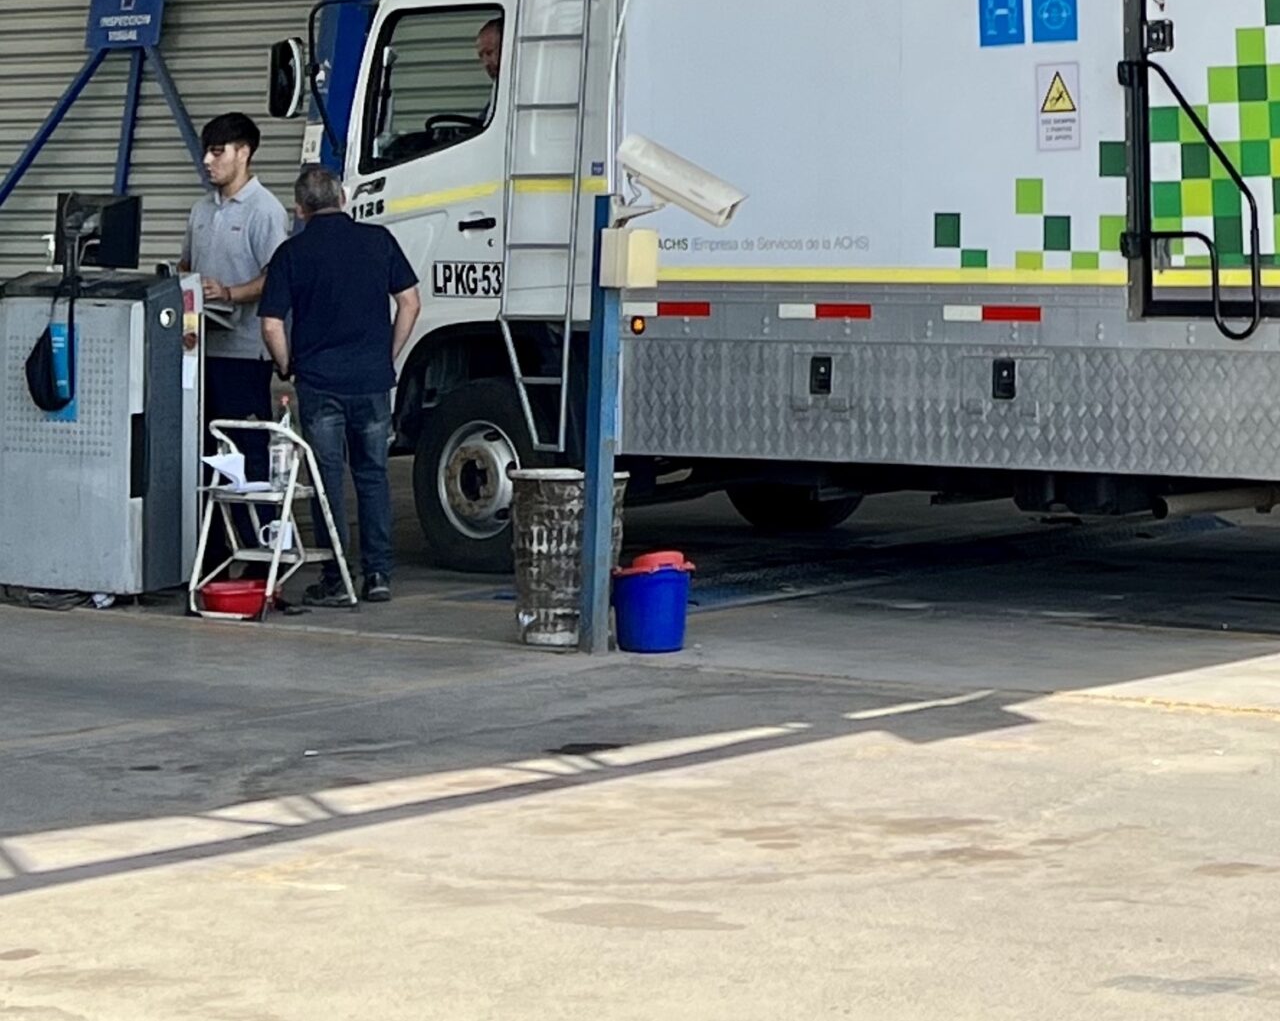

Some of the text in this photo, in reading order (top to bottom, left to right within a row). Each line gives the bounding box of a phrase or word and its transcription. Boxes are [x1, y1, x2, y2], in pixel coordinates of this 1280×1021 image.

[741, 237, 755, 251] de
[757, 237, 803, 251] Servicios
[805, 237, 819, 251] de
[821, 237, 831, 250] la
